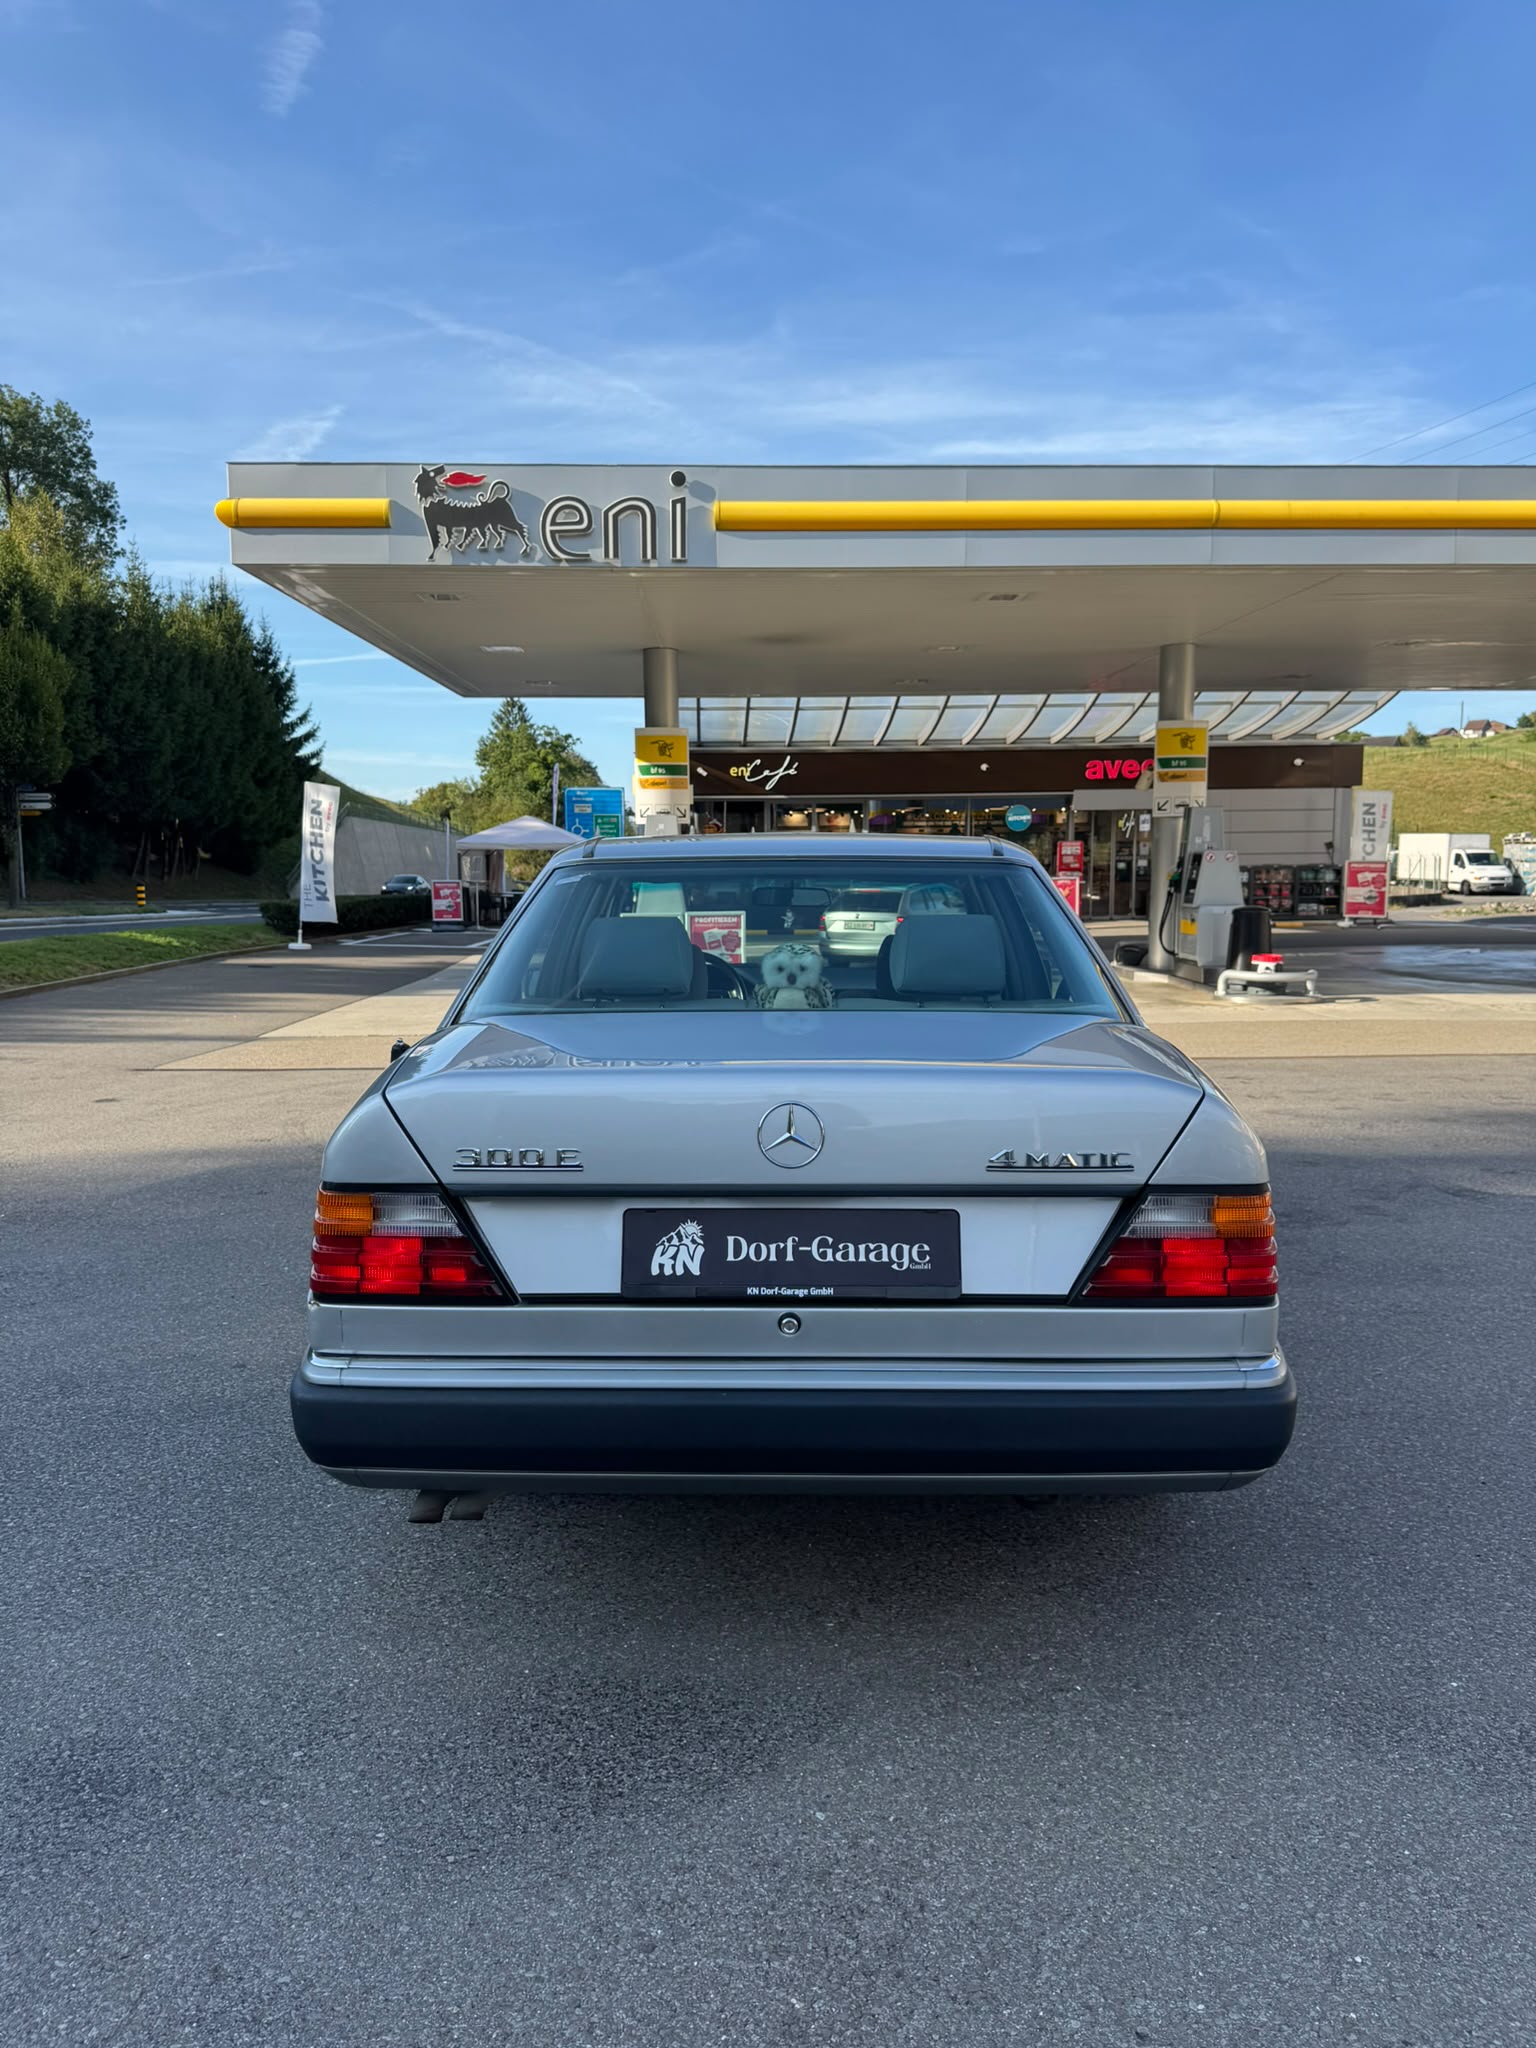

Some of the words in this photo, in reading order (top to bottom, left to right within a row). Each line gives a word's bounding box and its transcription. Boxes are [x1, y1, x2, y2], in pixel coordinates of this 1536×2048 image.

[540, 470, 687, 560] eni
[1362, 802, 1377, 860] CHEN
[310, 798, 330, 902] KITCHEN
[303, 884, 313, 907] THE
[651, 1244, 705, 1276] KN
[726, 1235, 931, 1271] Dorf-Garage
[746, 1287, 759, 1295] KN
[760, 1286, 808, 1297] Dorf-Garage
[810, 1286, 834, 1295] GmbH
